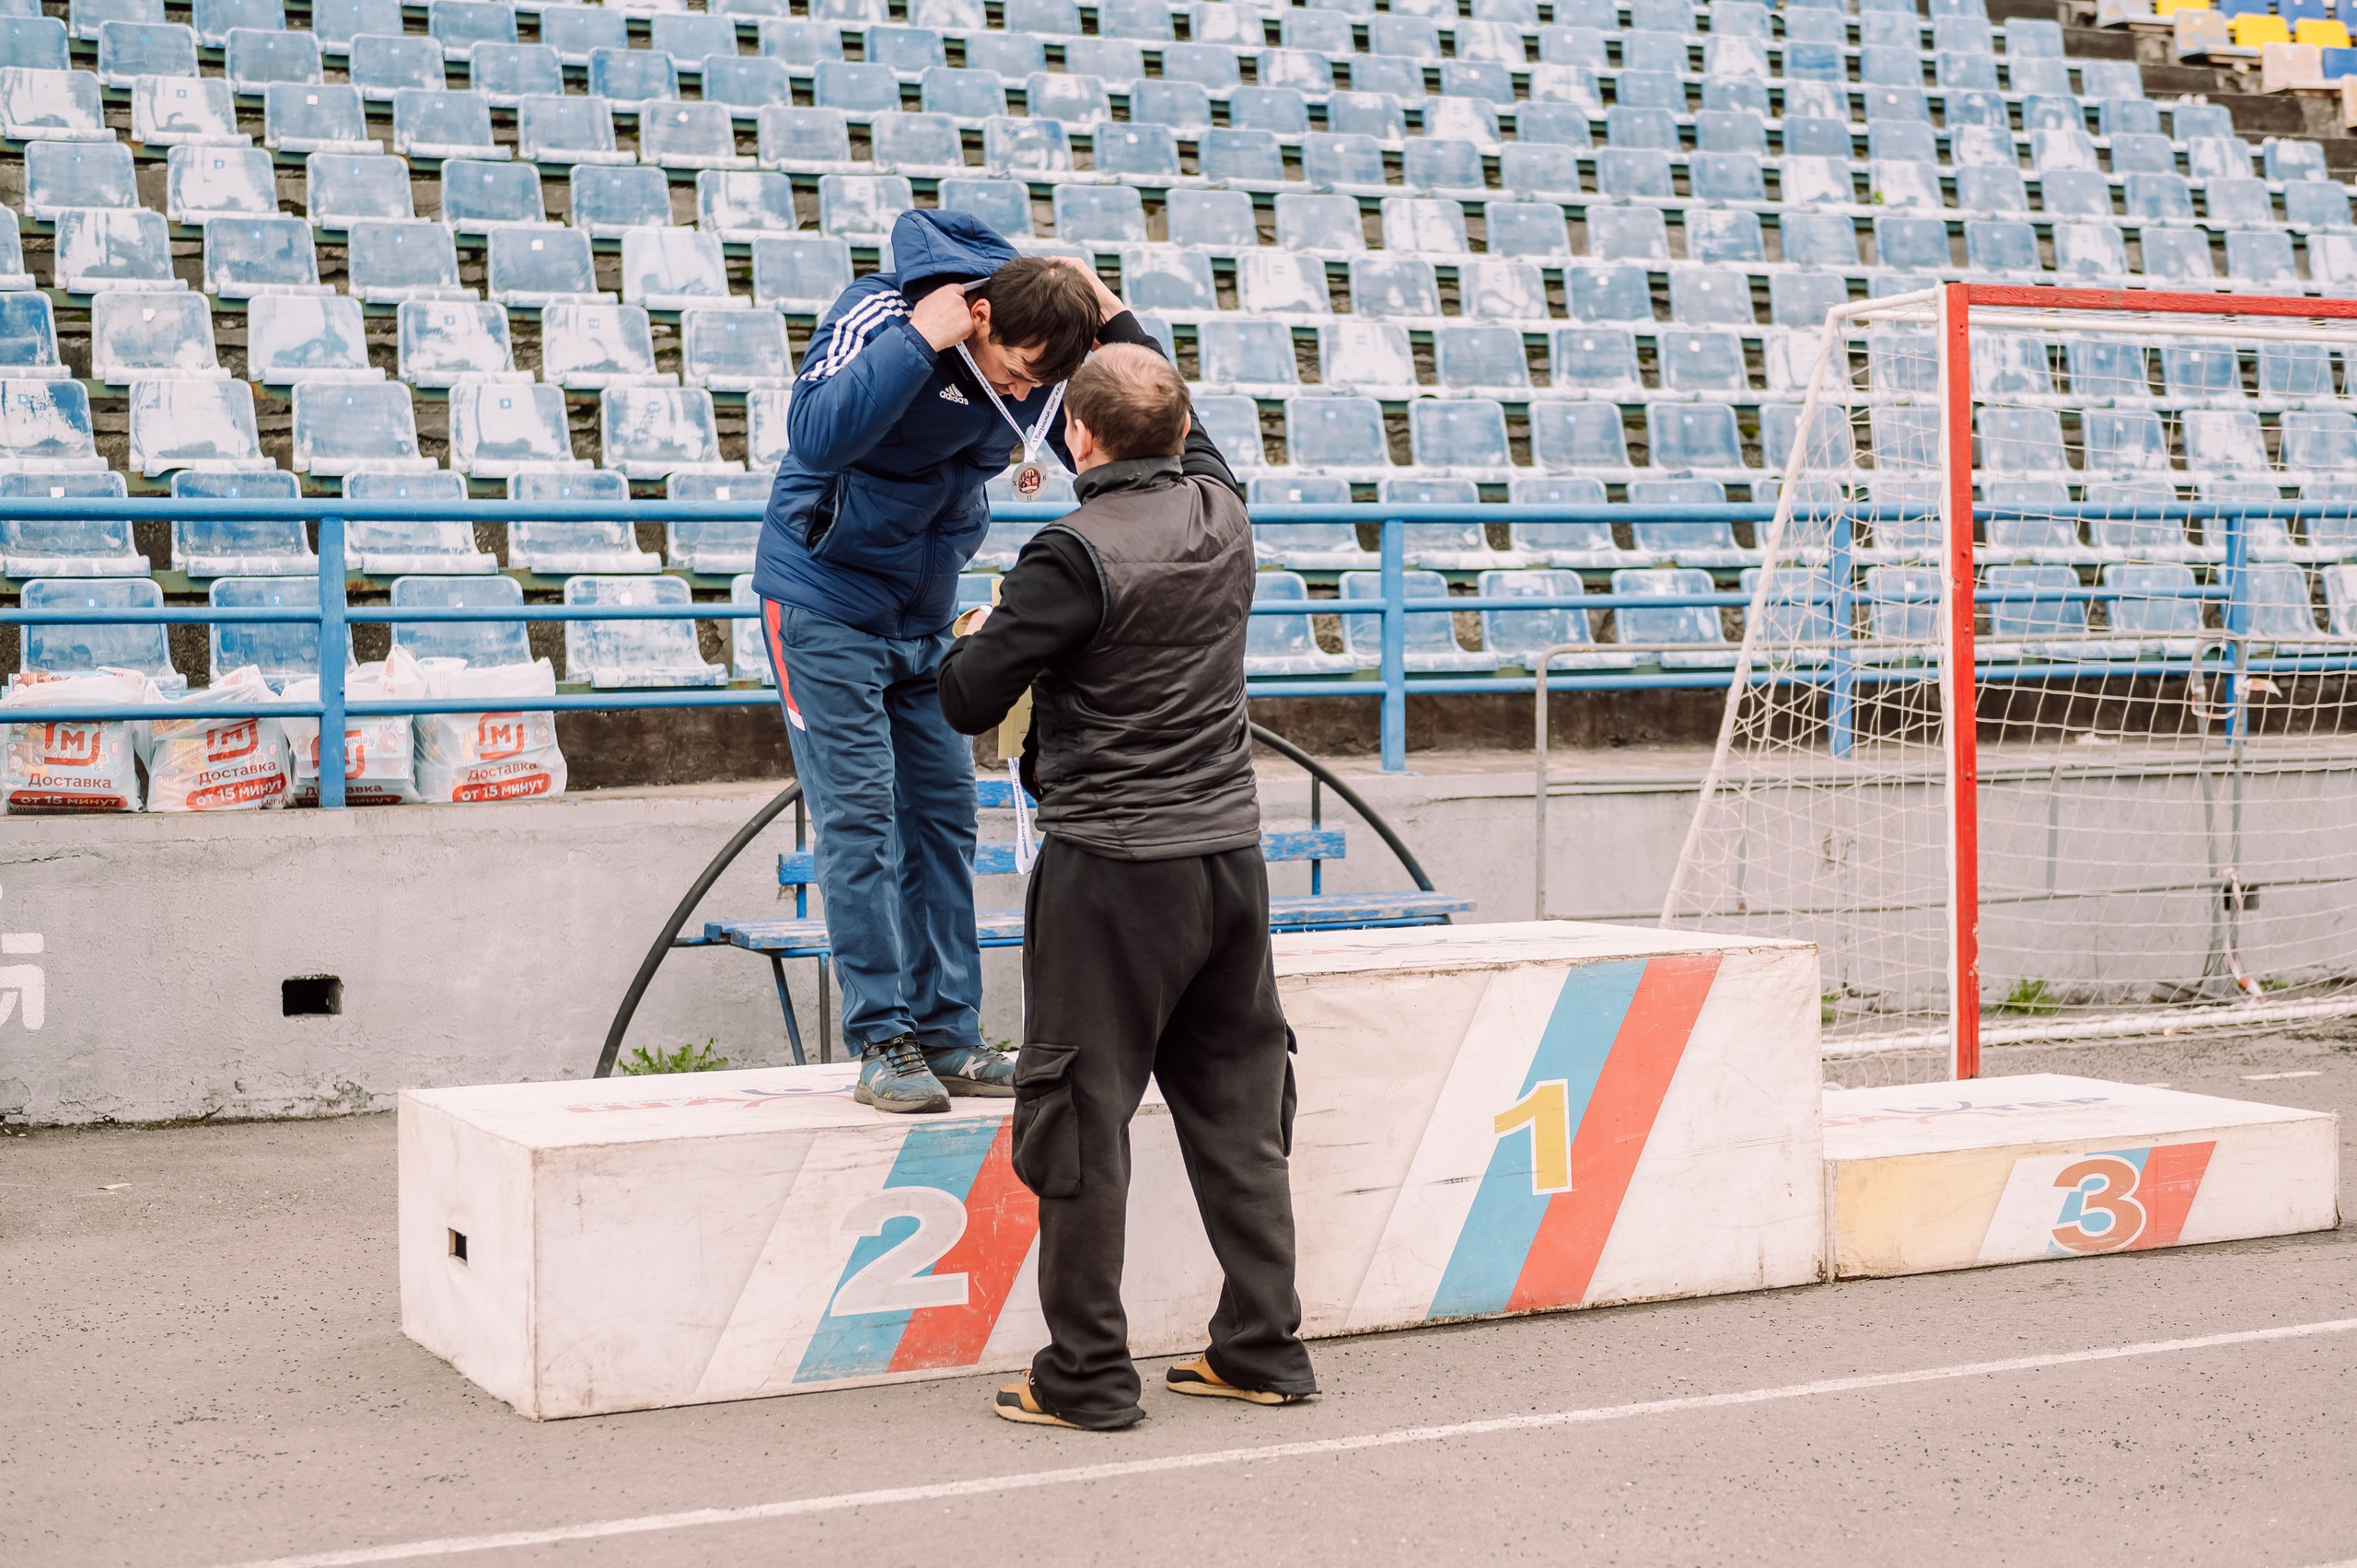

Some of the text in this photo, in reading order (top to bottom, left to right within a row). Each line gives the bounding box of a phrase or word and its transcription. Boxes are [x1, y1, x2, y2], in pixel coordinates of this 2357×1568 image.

[940, 390, 969, 405] adidas
[61, 730, 85, 751] М
[491, 724, 512, 746] М
[29, 773, 112, 789] Доставка
[199, 761, 276, 785] Доставка
[468, 762, 538, 782] Доставка
[196, 780, 282, 806] от 15 минут
[306, 784, 383, 796] Давка
[462, 779, 544, 801] от 15 минут
[44, 796, 63, 804] 15
[67, 796, 119, 807] минут
[958, 1056, 988, 1080] K
[1493, 1078, 1573, 1196] 1
[2050, 1155, 2147, 1251] 3
[830, 1186, 969, 1317] 2
